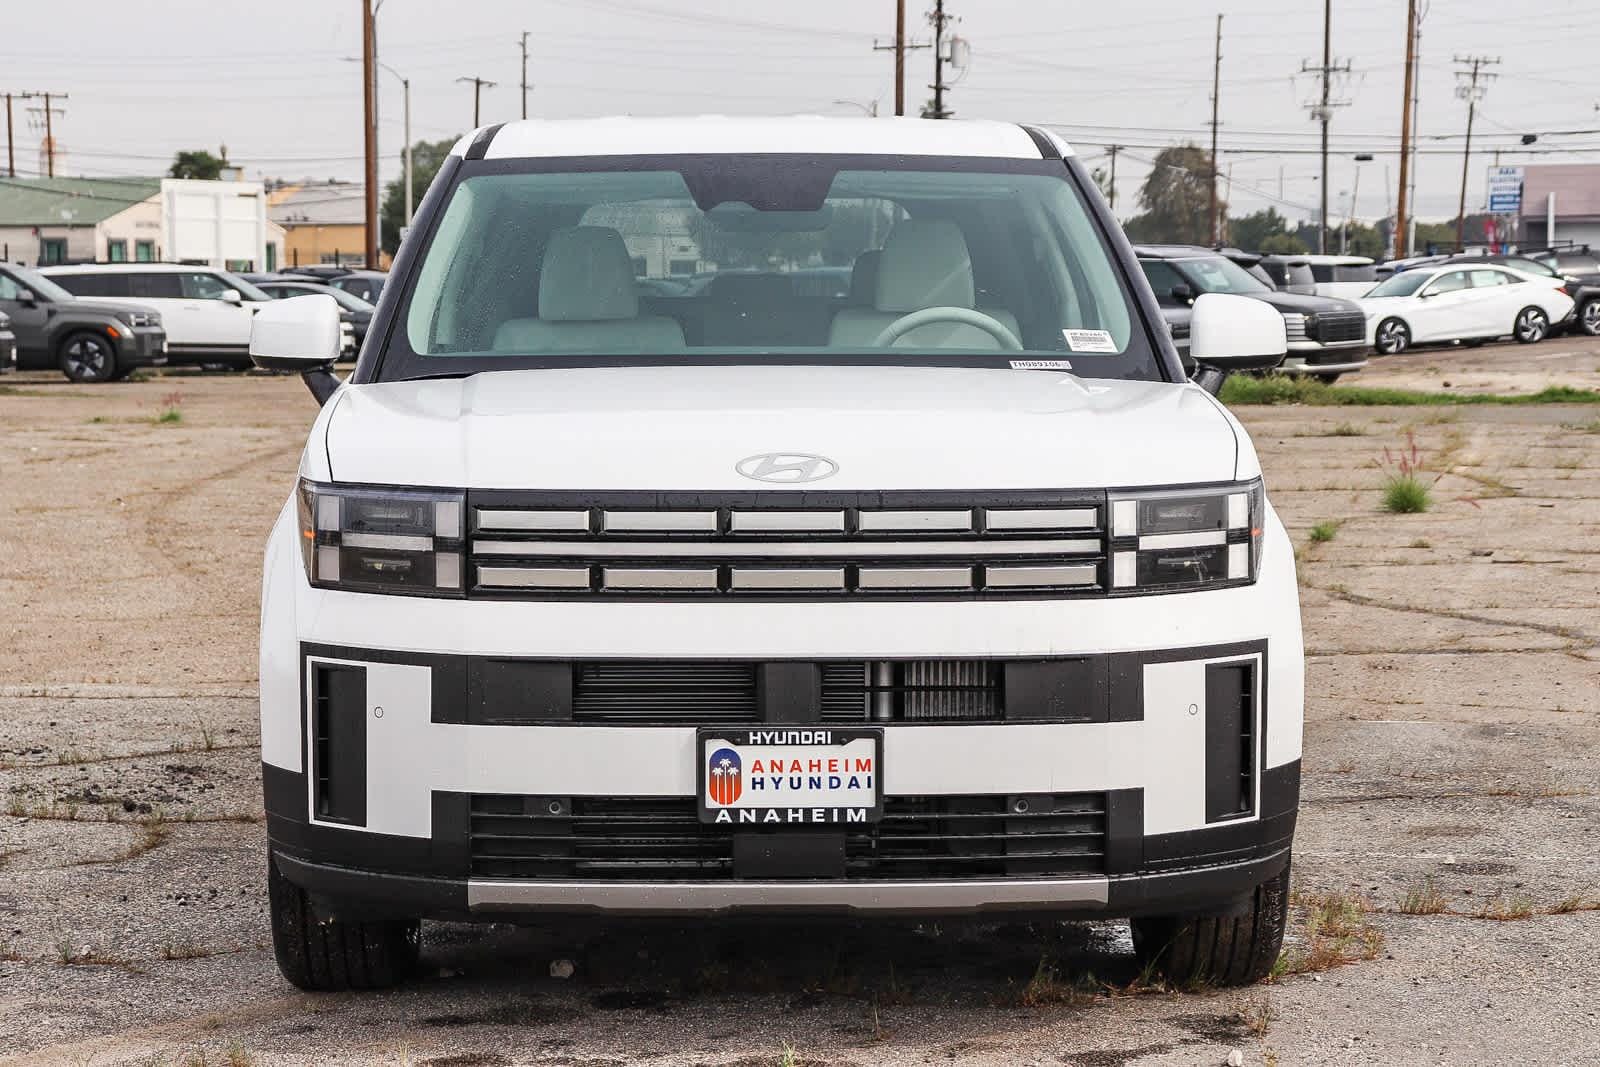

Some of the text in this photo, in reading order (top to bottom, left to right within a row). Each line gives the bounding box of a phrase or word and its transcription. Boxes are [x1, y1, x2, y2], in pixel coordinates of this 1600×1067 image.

[749, 731, 832, 745] HYUNDAI
[751, 758, 872, 773] ANAHEIM
[751, 775, 872, 790] HYUNDAI
[715, 808, 866, 824] ANAHEIM
